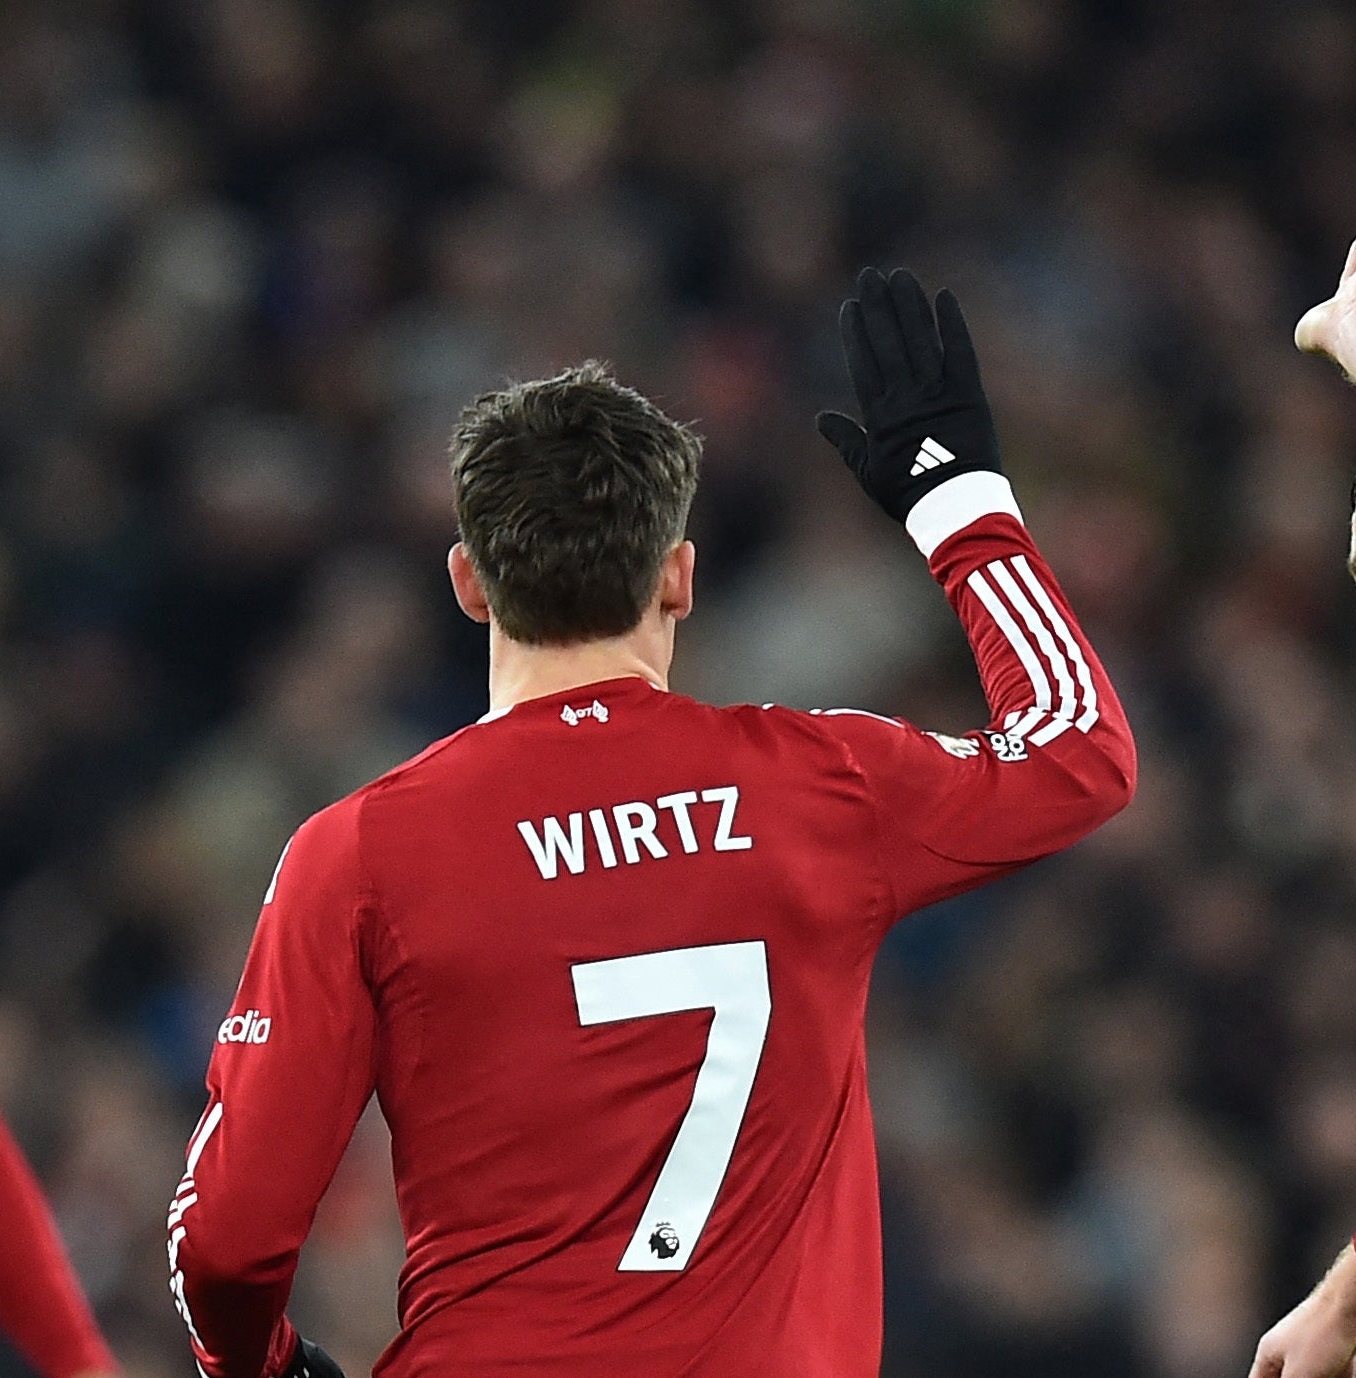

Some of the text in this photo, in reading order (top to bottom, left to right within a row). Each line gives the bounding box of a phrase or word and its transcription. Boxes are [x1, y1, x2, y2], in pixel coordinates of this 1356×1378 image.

[516, 785, 753, 880] WIRTZ
[217, 1009, 272, 1044] edia
[570, 939, 772, 1272] 7
